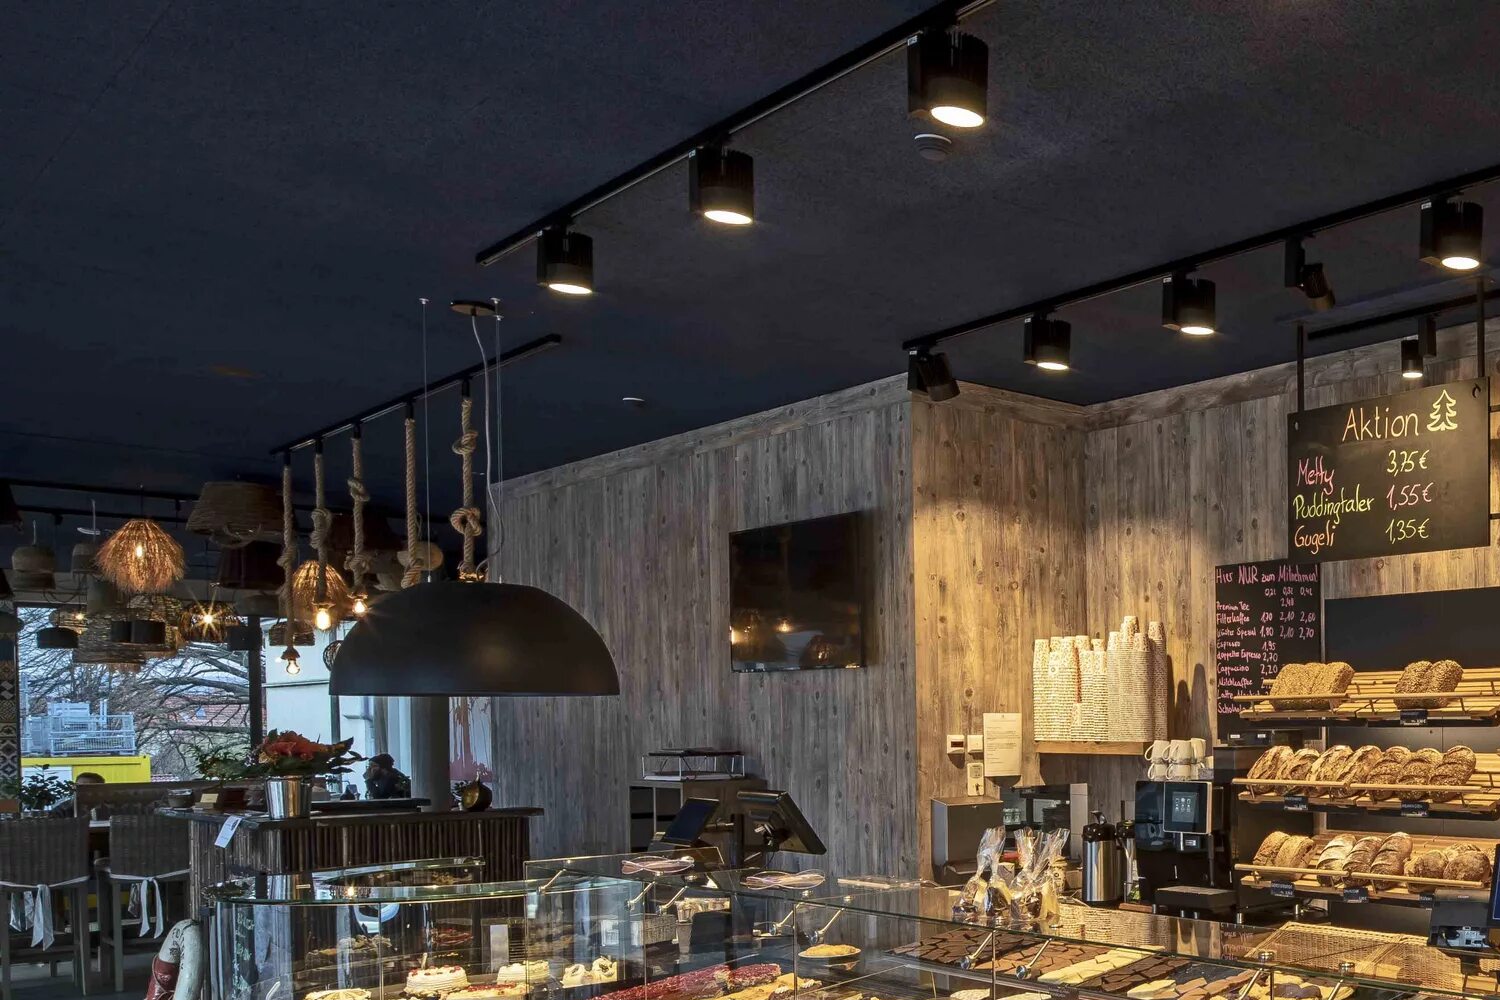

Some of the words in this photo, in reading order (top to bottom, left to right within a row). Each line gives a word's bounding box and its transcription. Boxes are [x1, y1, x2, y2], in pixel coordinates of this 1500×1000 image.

[1341, 406, 1420, 442] Aktion
[1293, 483, 1375, 525] Puddingtaler
[1294, 520, 1337, 555] Gugeli
[1216, 568, 1233, 584] Hier
[1238, 564, 1259, 585] NUR
[1261, 572, 1276, 582] zum
[1299, 626, 1315, 640] 2,70
[1260, 663, 1278, 675] 2,20
